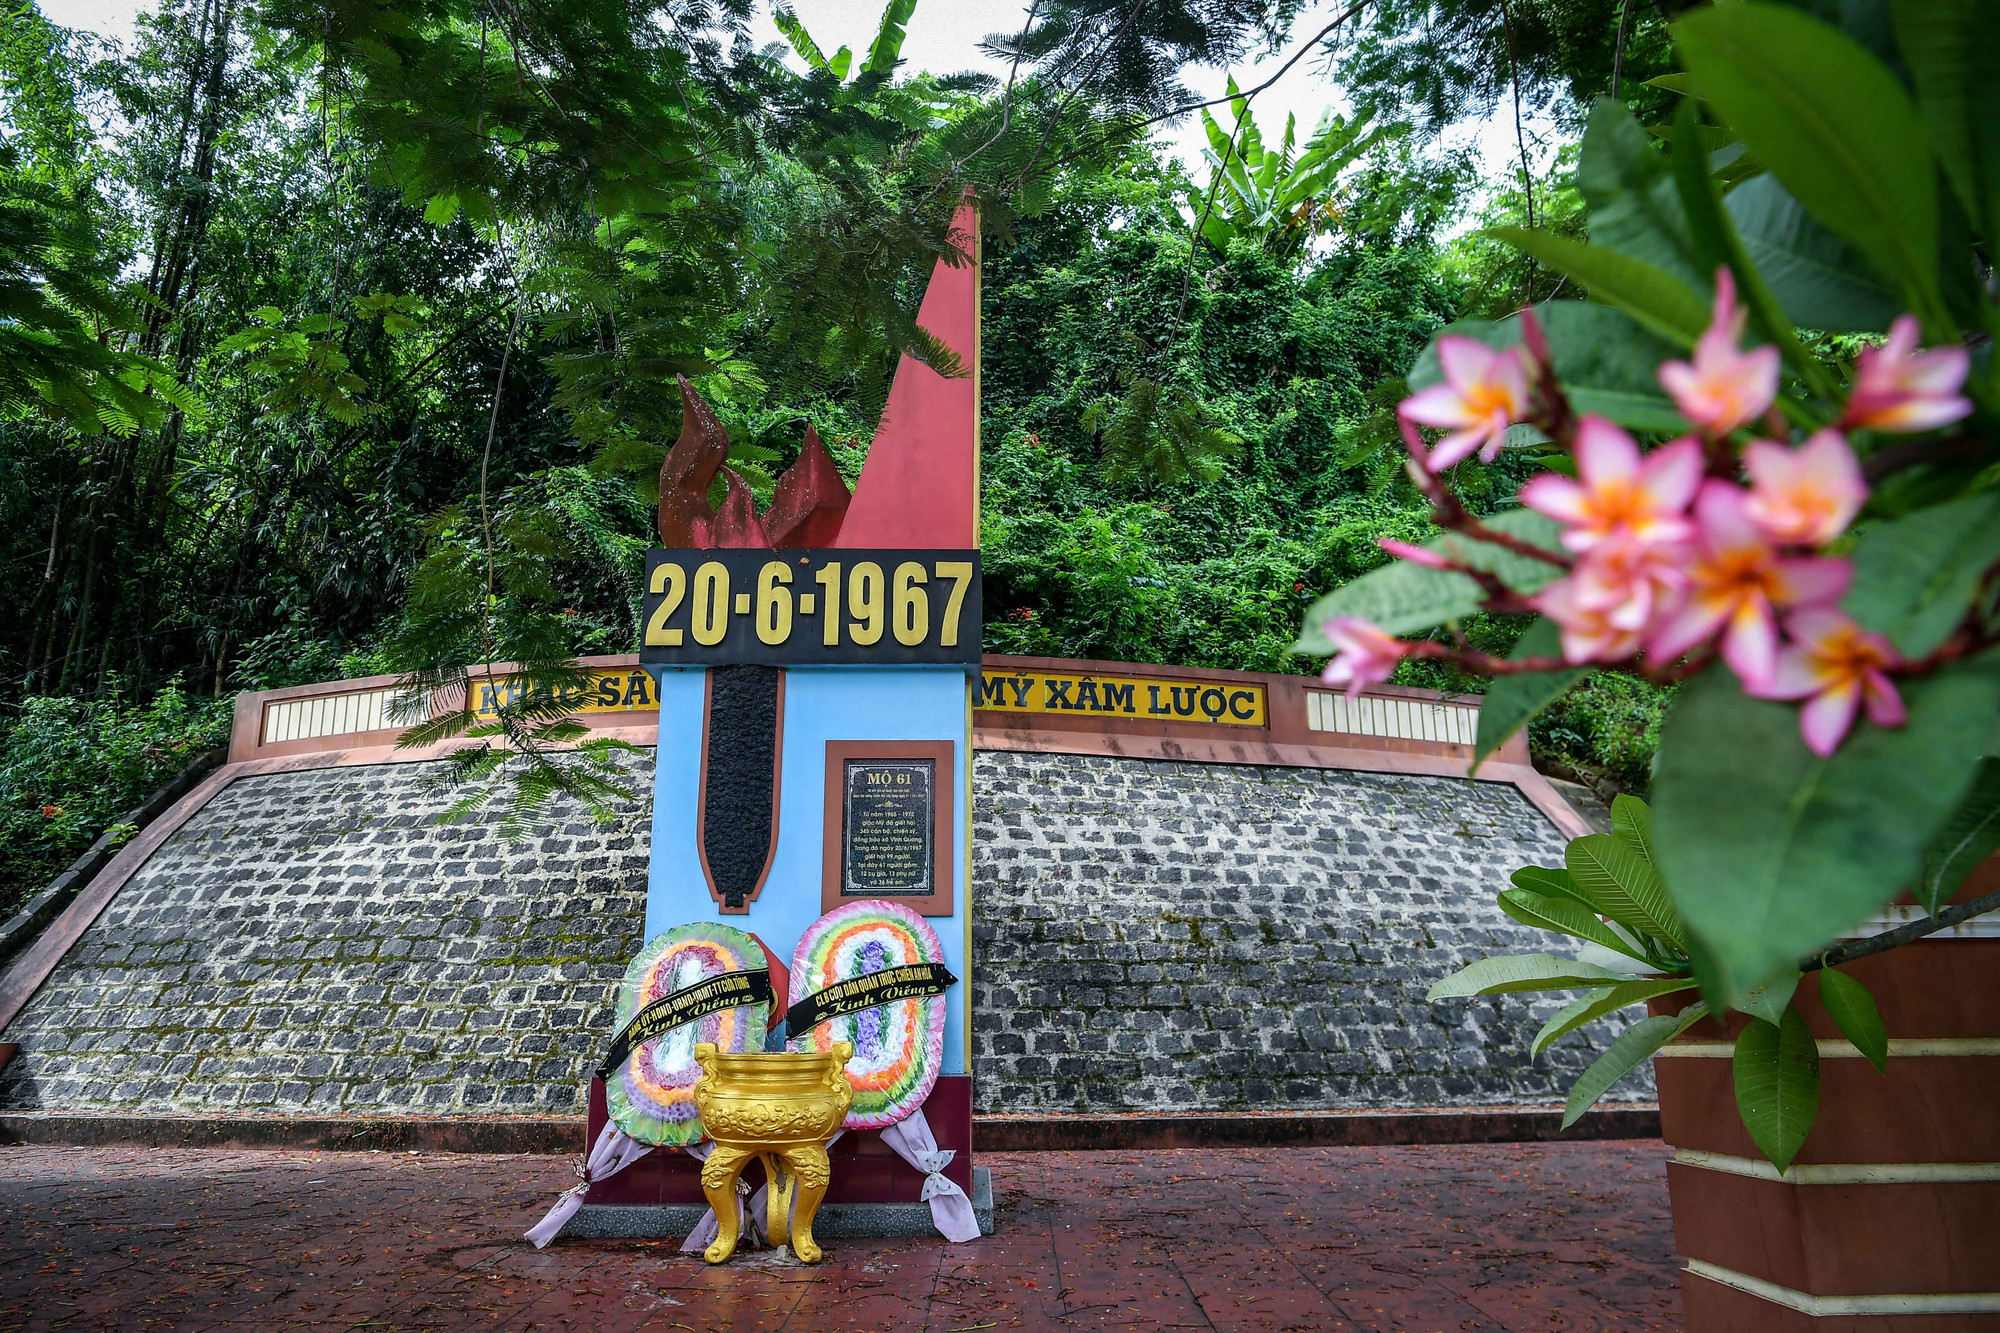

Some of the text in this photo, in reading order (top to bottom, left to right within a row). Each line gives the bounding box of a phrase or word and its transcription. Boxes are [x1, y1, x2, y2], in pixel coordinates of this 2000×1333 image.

[644, 561, 973, 647] 20-6-1967
[598, 671, 661, 707] SÂ
[980, 672, 1035, 708] MỸ
[1045, 676, 1136, 713] XÂM
[1147, 685, 1255, 722] LƯỢC
[867, 770, 912, 787] MỘ 61
[815, 992, 830, 1007] CLB
